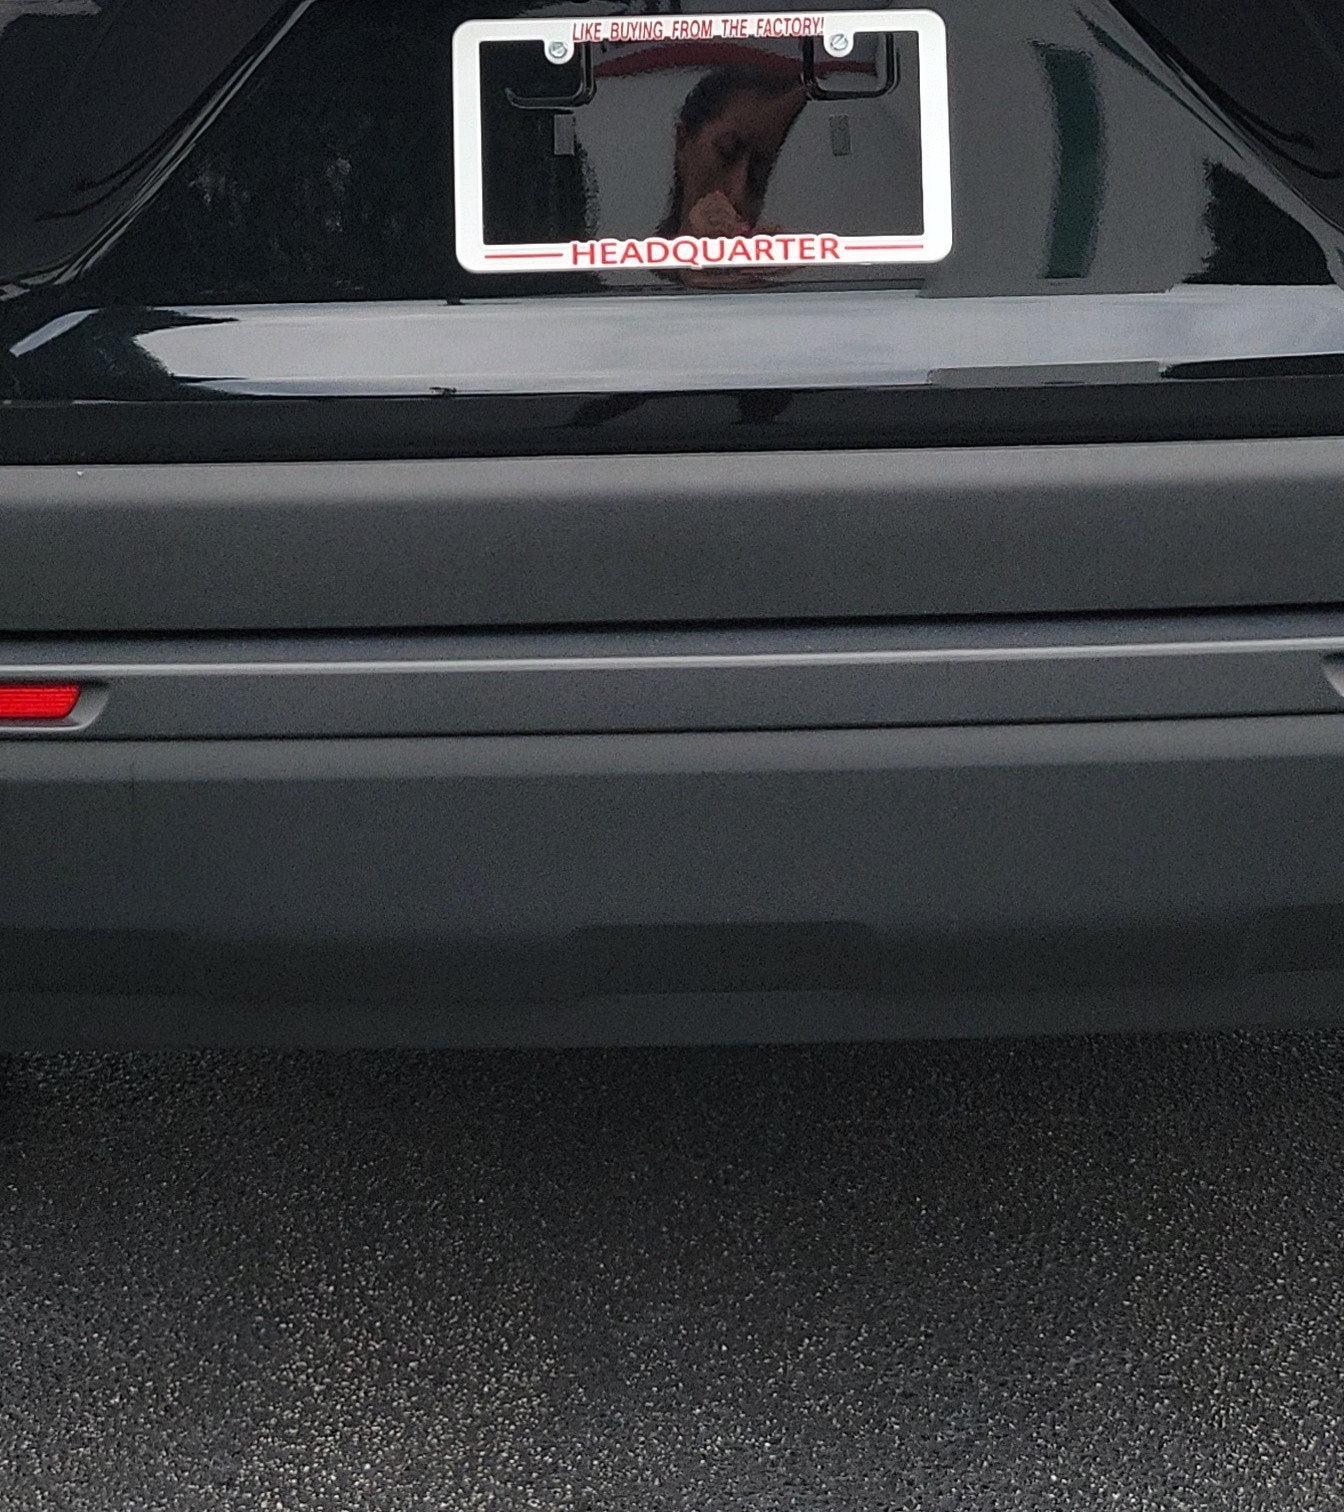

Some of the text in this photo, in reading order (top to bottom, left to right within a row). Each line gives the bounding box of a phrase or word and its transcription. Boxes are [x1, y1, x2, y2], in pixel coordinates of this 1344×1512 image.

[573, 16, 824, 42] LIKE BUYING FROM THE FACTORY!
[572, 238, 842, 265] HEADQUARTER
